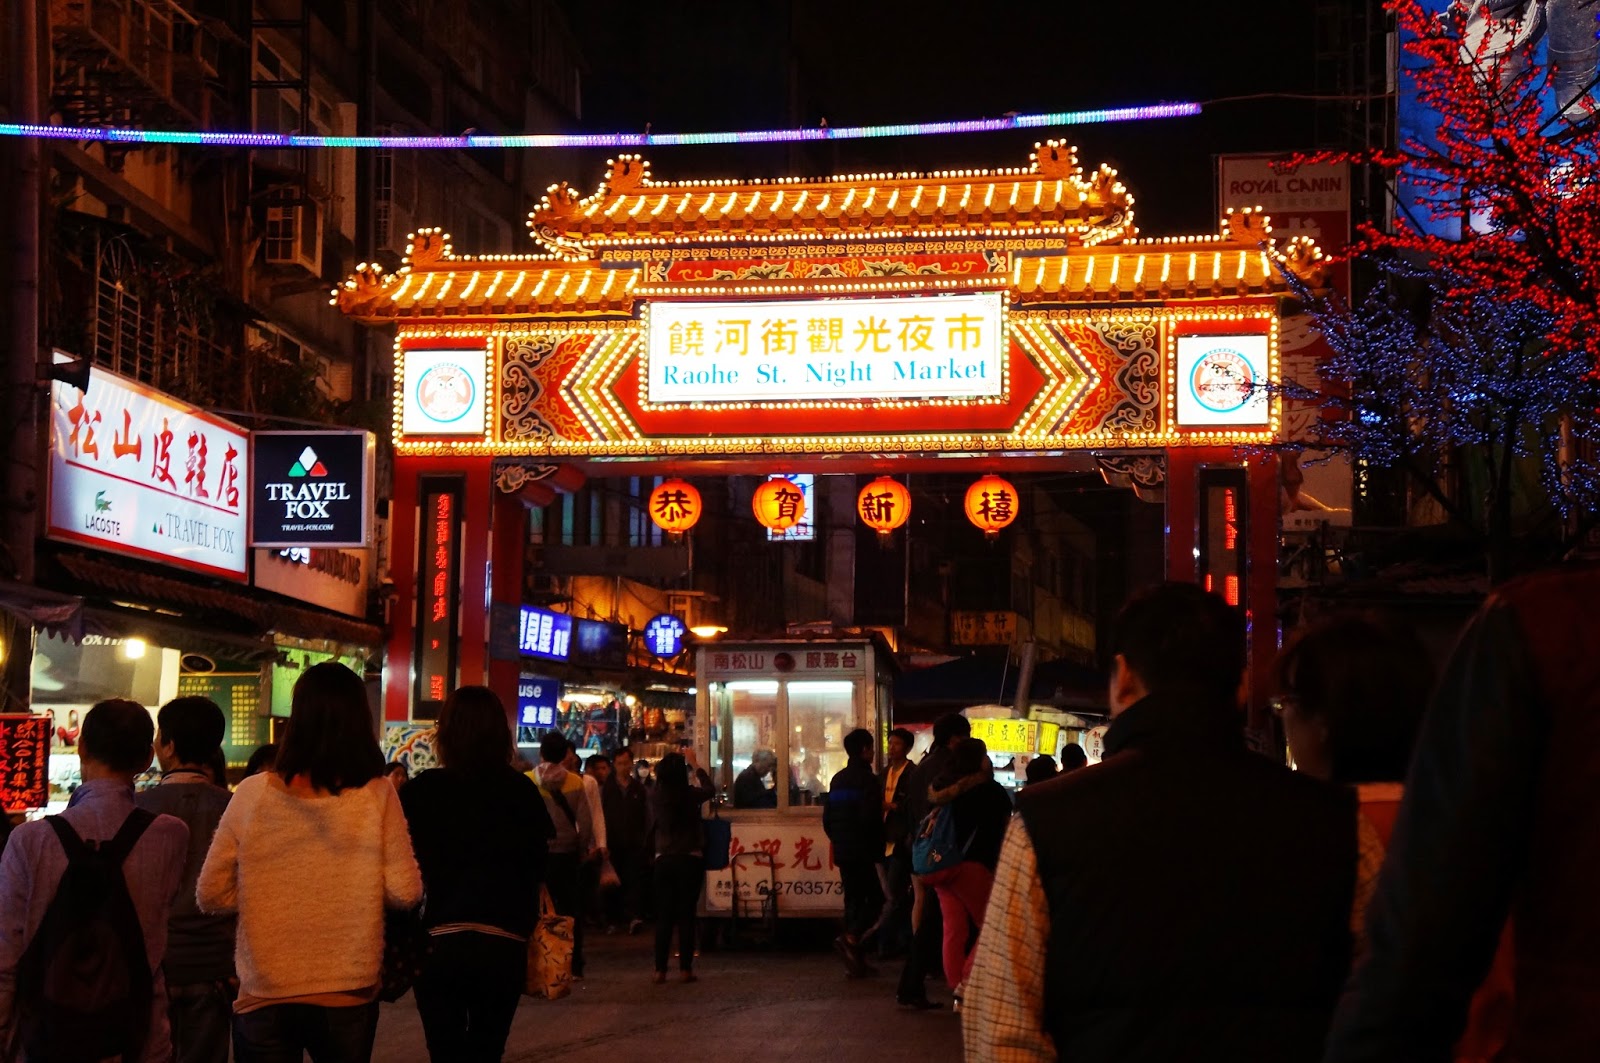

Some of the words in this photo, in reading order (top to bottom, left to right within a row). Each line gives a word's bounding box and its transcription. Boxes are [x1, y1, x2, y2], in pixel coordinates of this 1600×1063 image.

[1229, 179, 1282, 195] ROYAL
[1286, 177, 1342, 193] CANIN
[668, 312, 986, 358] 饒河街觀光夜市
[663, 363, 739, 386] Raohe
[756, 363, 786, 385] St.
[805, 361, 873, 388] Night
[893, 358, 987, 381] Market
[67, 396, 240, 508] 松山皮鞋店
[264, 482, 351, 501] TRAVEL
[654, 489, 693, 523] 恭
[773, 487, 801, 523] 賀
[861, 491, 895, 523] 新
[975, 489, 1013, 522] 禧
[85, 513, 121, 537] LACOSTE
[284, 500, 330, 519] FOX
[166, 512, 210, 548] TRAVEL
[212, 526, 235, 554] FOX
[714, 652, 765, 670] 南松山
[805, 651, 857, 669] 服務台
